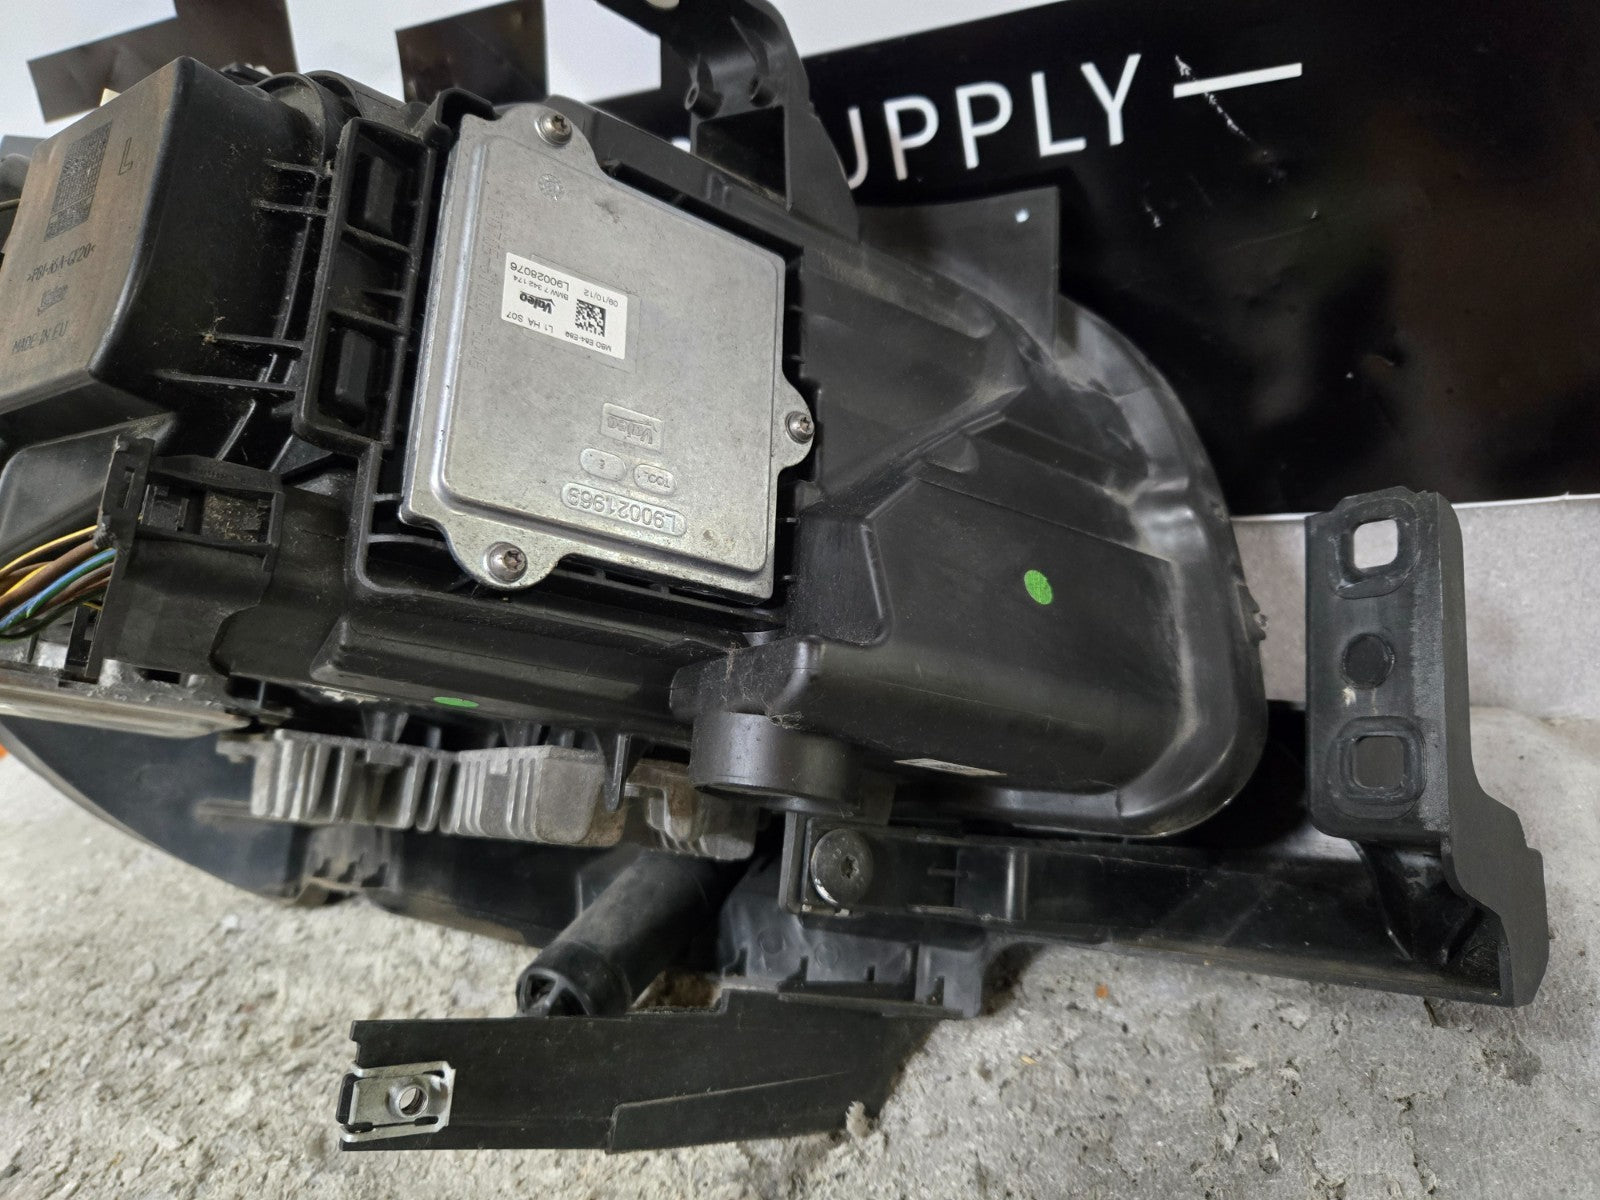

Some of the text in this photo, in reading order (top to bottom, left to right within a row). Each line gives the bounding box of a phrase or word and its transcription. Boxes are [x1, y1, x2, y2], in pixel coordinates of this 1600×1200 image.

[510, 261, 570, 292] L90028076
[513, 275, 527, 285] 174
[528, 280, 542, 291] 342
[551, 289, 569, 301] BMW
[519, 291, 555, 314] Valeo
[506, 311, 524, 323] S07
[528, 317, 541, 329] HA
